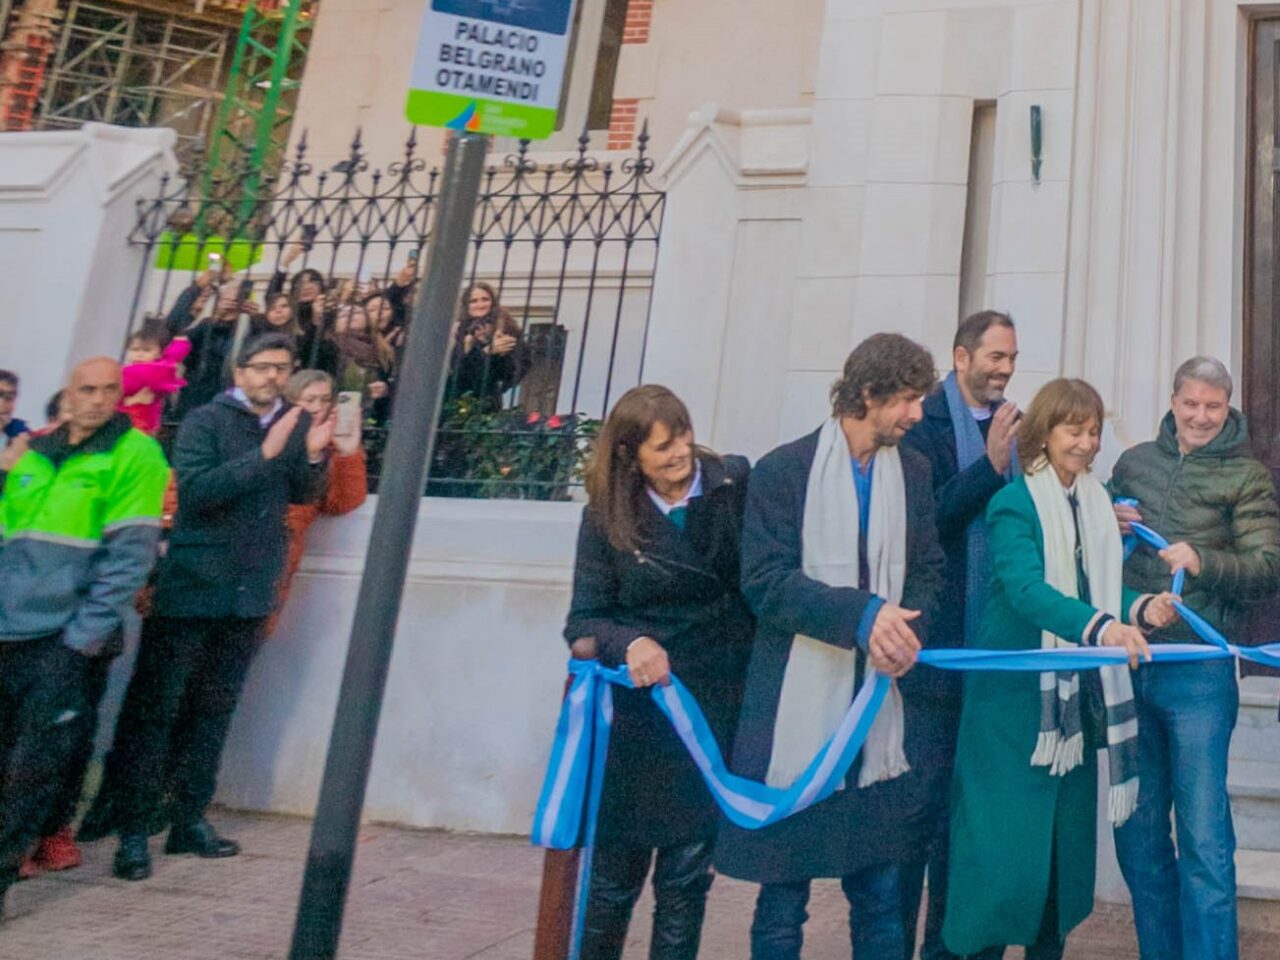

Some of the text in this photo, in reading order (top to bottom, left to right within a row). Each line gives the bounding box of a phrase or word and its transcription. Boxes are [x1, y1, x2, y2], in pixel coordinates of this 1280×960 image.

[455, 22, 538, 52] PALACIO
[438, 44, 546, 78] BELGRANO
[436, 68, 540, 101] OTAMENDI
